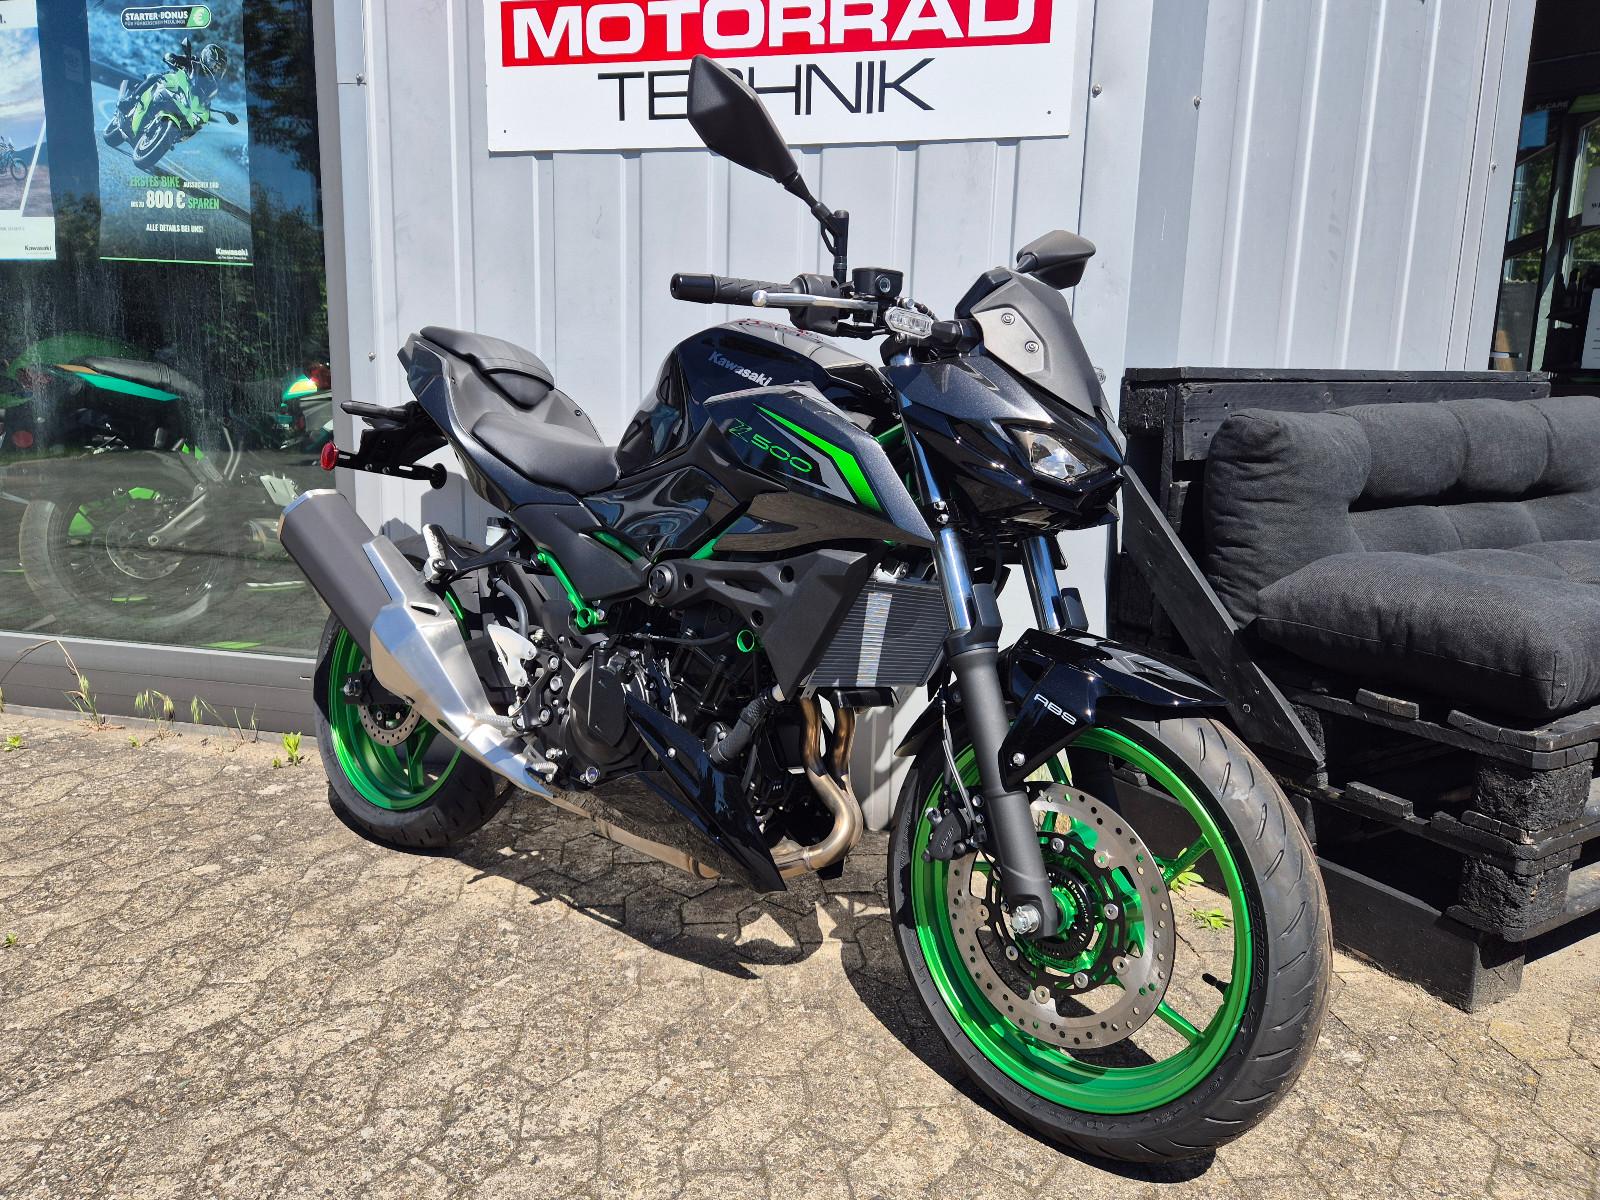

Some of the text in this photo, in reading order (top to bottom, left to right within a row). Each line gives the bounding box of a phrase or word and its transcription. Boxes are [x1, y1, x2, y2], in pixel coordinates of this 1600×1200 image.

[125, 11, 188, 20] STARTER-BONUS
[513, 0, 1036, 59] MOTORRAD
[598, 58, 936, 121] TEHNIK
[130, 176, 159, 187] ERSTES
[161, 176, 180, 187] BIKE
[146, 190, 173, 208] 800
[176, 190, 186, 209] €
[188, 198, 219, 209] SPAREN
[146, 223, 204, 233] ALLE DETAILS BEI UNS!
[215, 247, 249, 256] Kawasaki
[708, 351, 773, 387] Kawasaki
[1034, 694, 1077, 725] ABS
